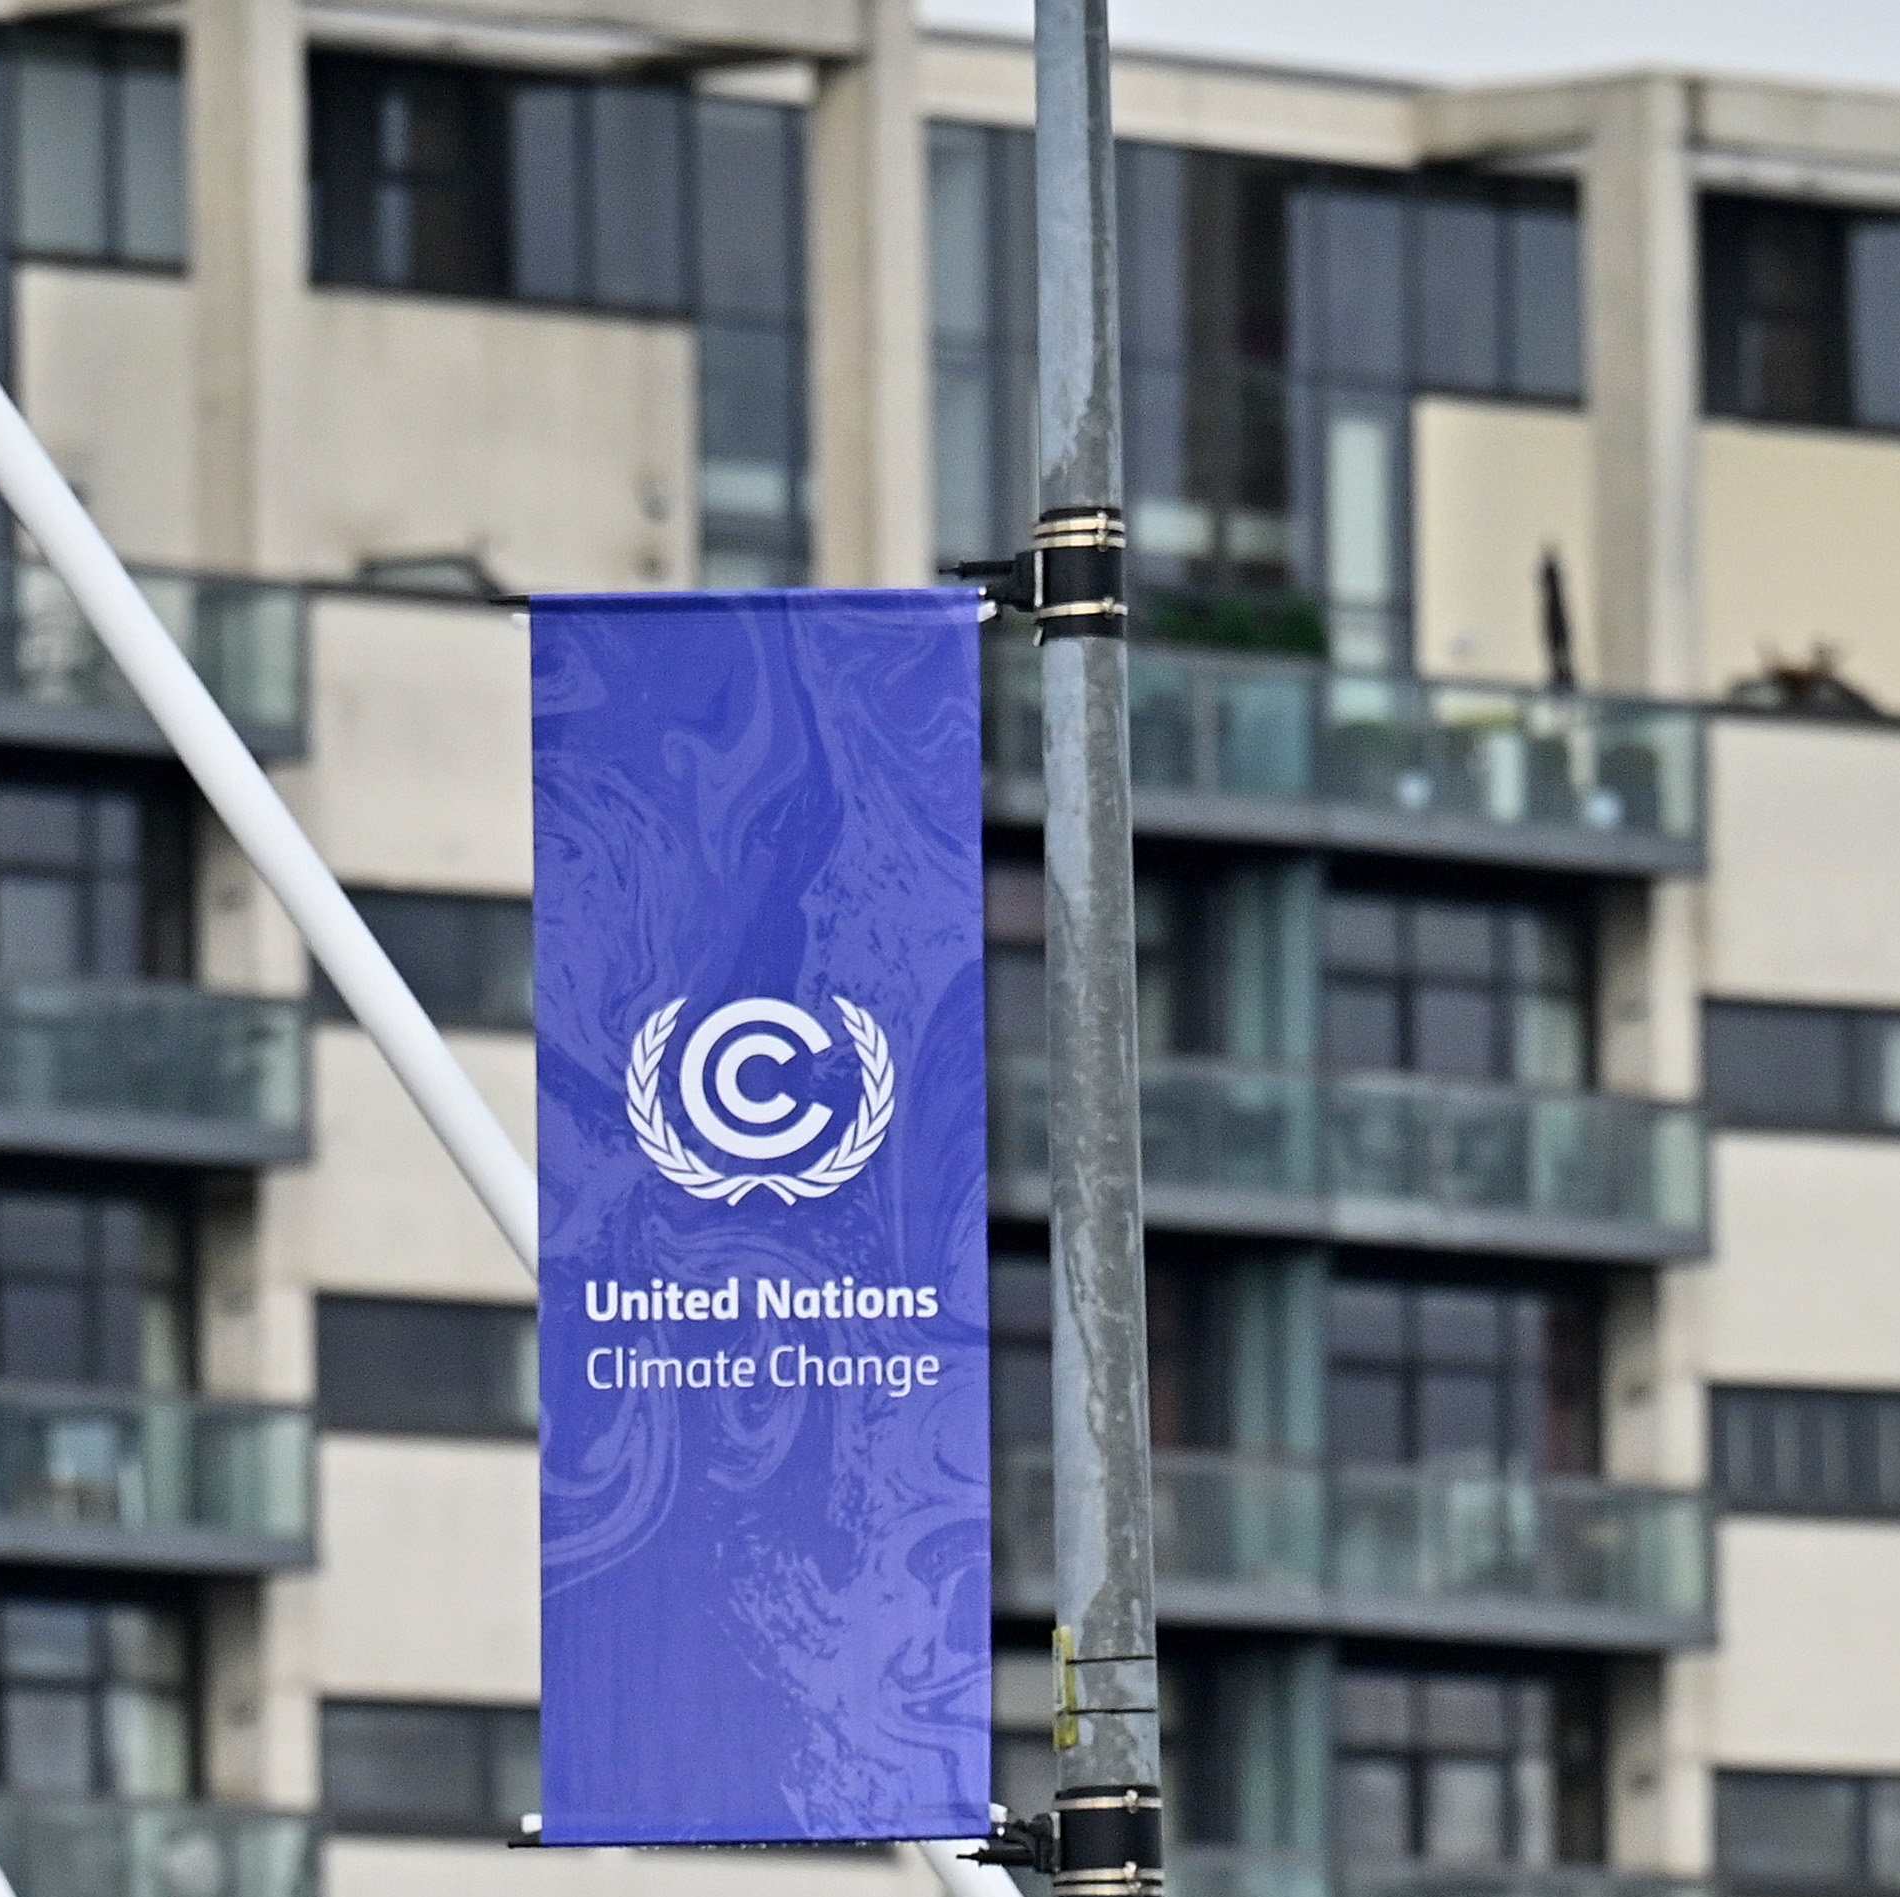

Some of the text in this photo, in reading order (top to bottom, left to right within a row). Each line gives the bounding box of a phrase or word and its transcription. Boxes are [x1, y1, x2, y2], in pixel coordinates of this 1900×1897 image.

[585, 1276, 939, 1321] United Nations
[586, 1344, 940, 1398] Climate Change
